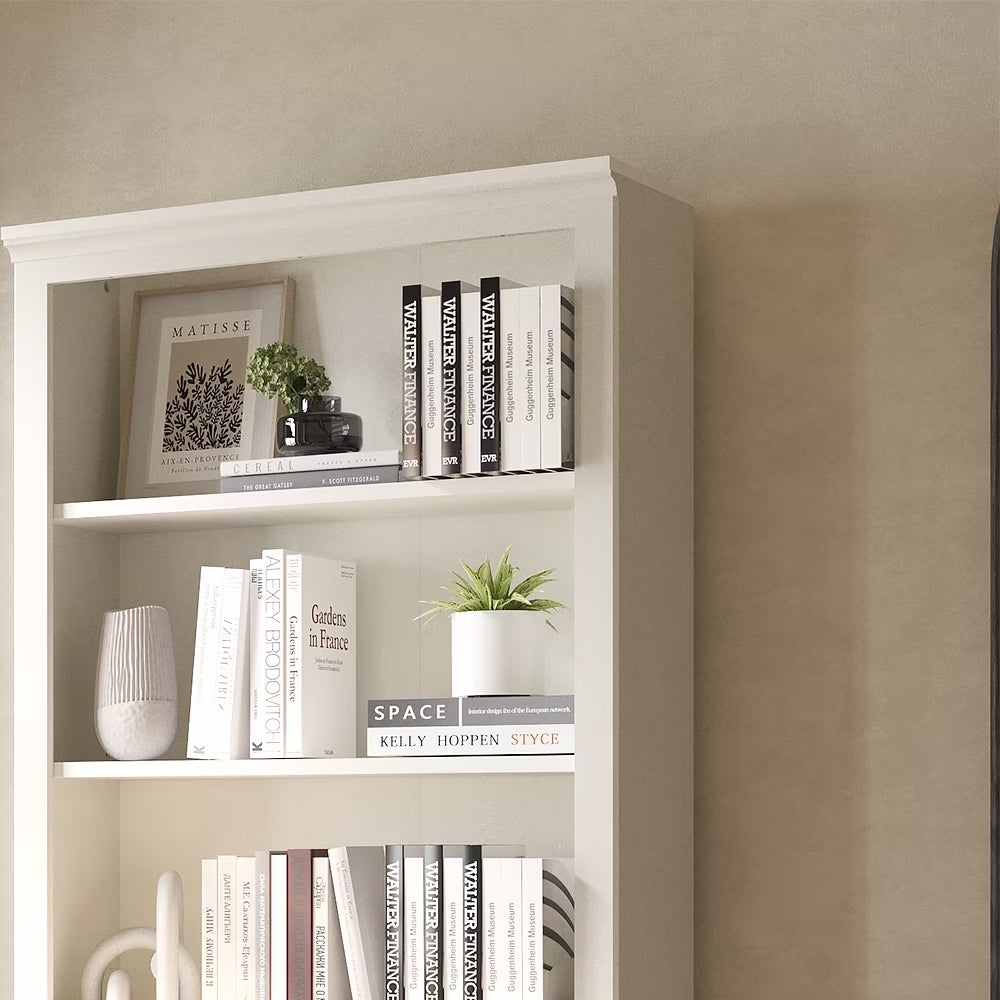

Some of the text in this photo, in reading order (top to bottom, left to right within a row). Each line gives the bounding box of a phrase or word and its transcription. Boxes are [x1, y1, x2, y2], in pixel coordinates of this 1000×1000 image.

[172, 320, 250, 337] MATISSE
[467, 372, 476, 426] Guggenheim
[506, 370, 515, 423] Guggenheim
[526, 368, 536, 422] Guggenheim
[546, 329, 556, 420] Guggenheim Museum
[403, 371, 417, 445] FINANCE
[427, 376, 437, 429] Guggenheim
[443, 368, 456, 442] FINANCE
[482, 365, 495, 440] FINANCE
[233, 460, 294, 474] CEREAL
[347, 475, 380, 483] FITZGERALD
[403, 460, 419, 468] EVR
[442, 457, 458, 465] EVR
[481, 454, 497, 463] EVR
[309, 628, 349, 651] in France
[311, 604, 347, 628] Gardens
[265, 555, 281, 745] ALEXEY BRODOVITCH
[289, 615, 299, 703] Gardens in France
[374, 704, 447, 721] SPACE
[380, 732, 559, 748] KELLY HOPPEN STYCE
[205, 907, 214, 934] МИРУ
[223, 873, 232, 944] ДАНТЕ АЛИГЬЕРИ
[240, 900, 251, 981] Салтыков-Щедрин
[315, 925, 326, 969] РАССКАЖИ
[410, 937, 419, 990] Guggenheim
[449, 937, 459, 991] Guggenheim
[488, 938, 497, 992] Guggenheim
[508, 938, 517, 992] Guggenheim
[528, 902, 538, 993] Guggenheim Museum
[315, 970, 326, 988] МНЕ
